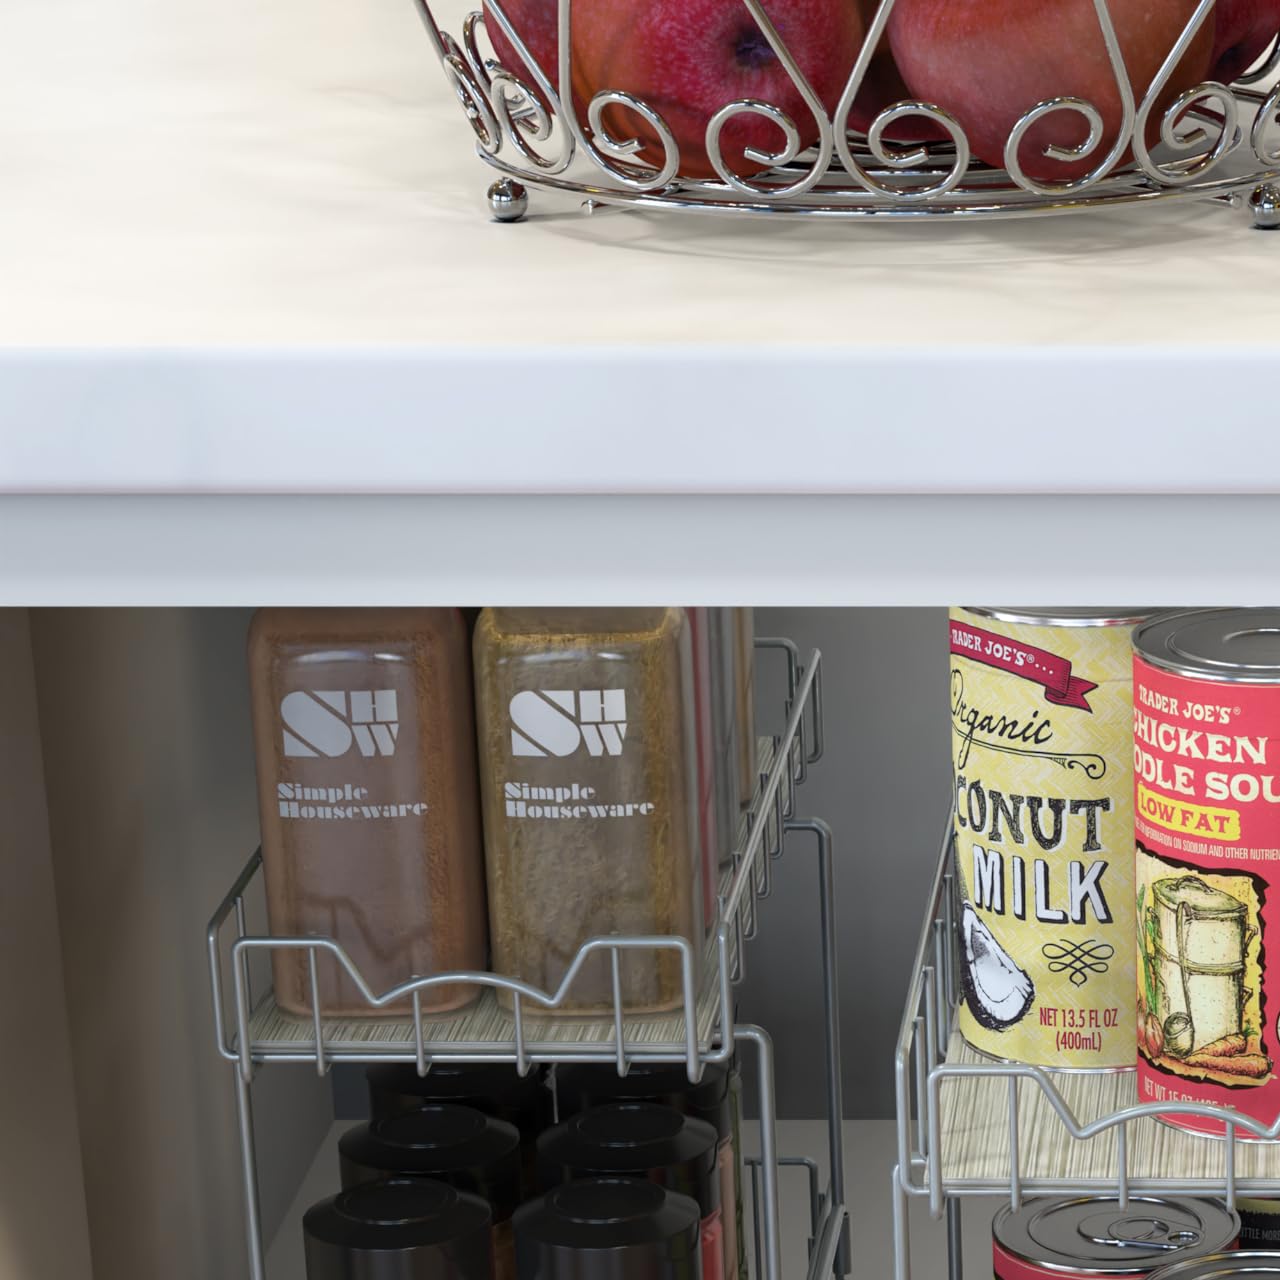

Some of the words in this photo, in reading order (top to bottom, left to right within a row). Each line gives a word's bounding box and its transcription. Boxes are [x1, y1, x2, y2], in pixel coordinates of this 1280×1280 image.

[1139, 684, 1179, 716] TRADER
[276, 782, 368, 803] Simple
[504, 782, 597, 803] Simple
[278, 800, 429, 820] Houseware
[505, 800, 656, 820] Houseware
[1140, 792, 1176, 824] LOW
[1181, 808, 1230, 834] FAT
[1208, 844, 1224, 858] AND
[1225, 846, 1248, 860] OTHER
[972, 843, 1114, 924] MILK
[1039, 1007, 1058, 1026] NET
[1061, 1009, 1086, 1027] 13.5
[1089, 1009, 1101, 1027] FL
[1103, 1008, 1118, 1027] OZ
[1056, 1031, 1102, 1052] (400mL)
